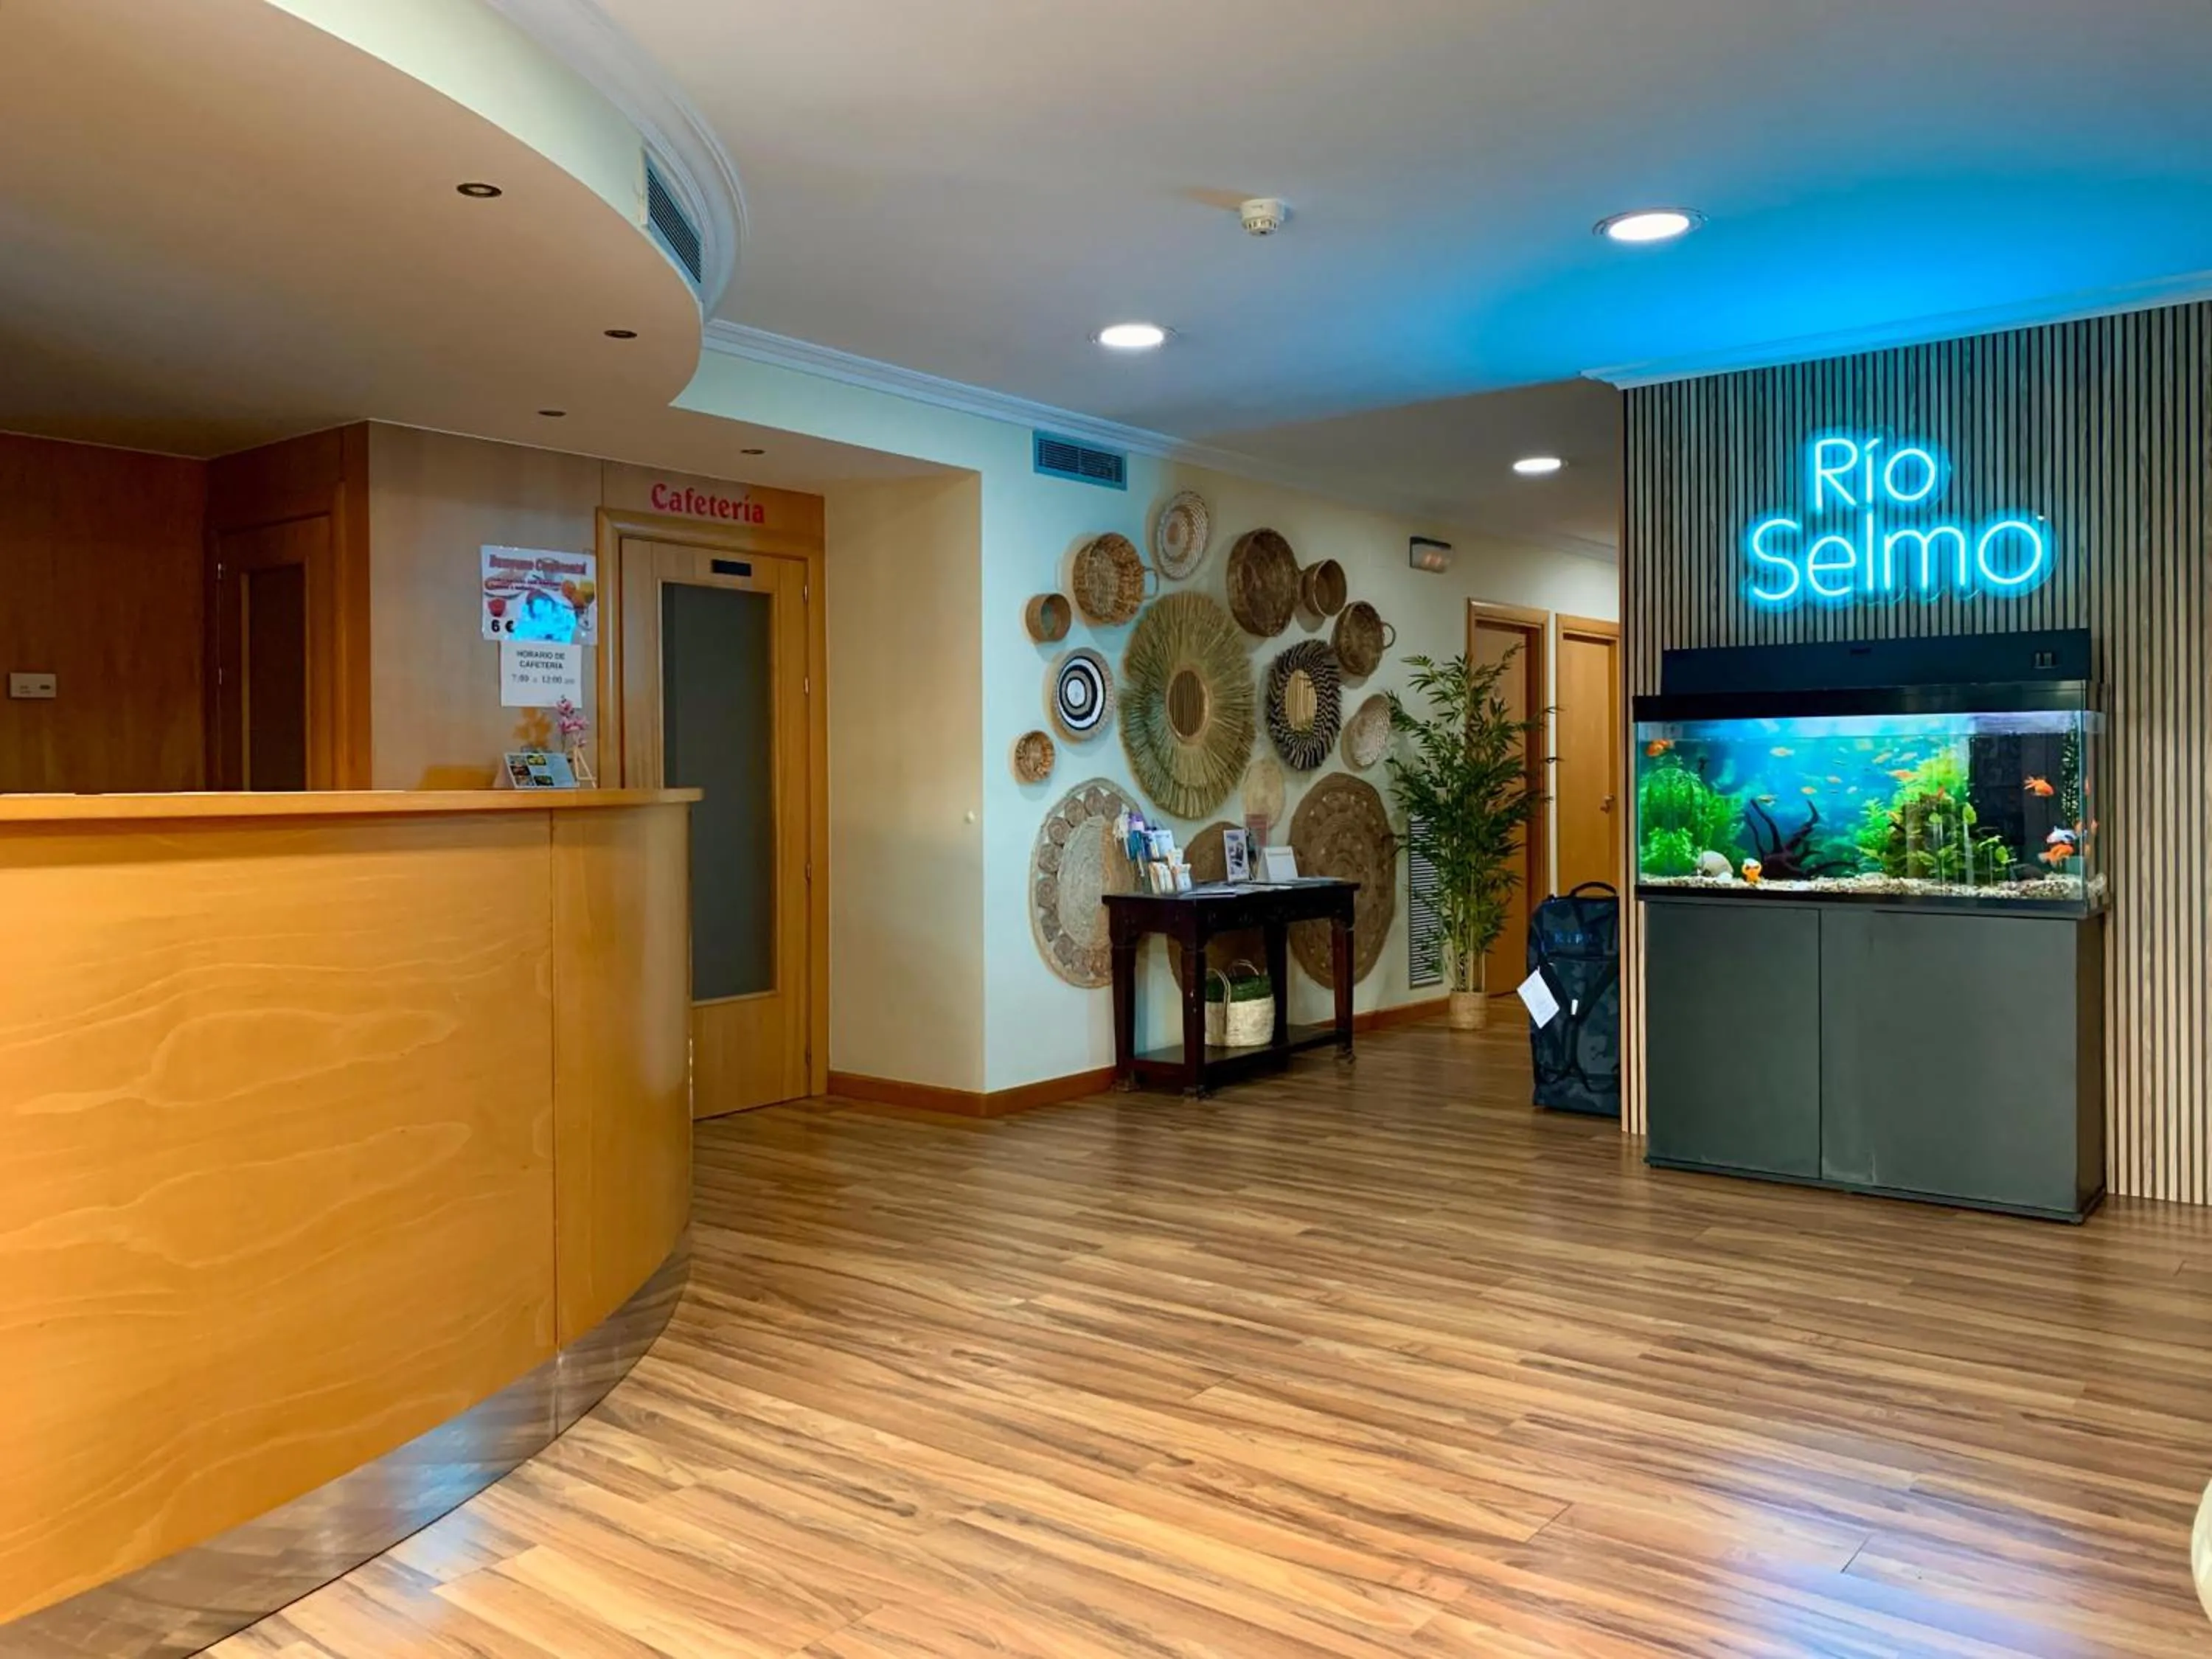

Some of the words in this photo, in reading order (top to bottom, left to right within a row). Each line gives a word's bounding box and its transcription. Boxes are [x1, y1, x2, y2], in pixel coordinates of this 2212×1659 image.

[651, 483, 765, 524] Cafetería
[1813, 436, 1937, 515] Río
[1752, 512, 2043, 601] Selmo
[492, 619, 501, 633] 6
